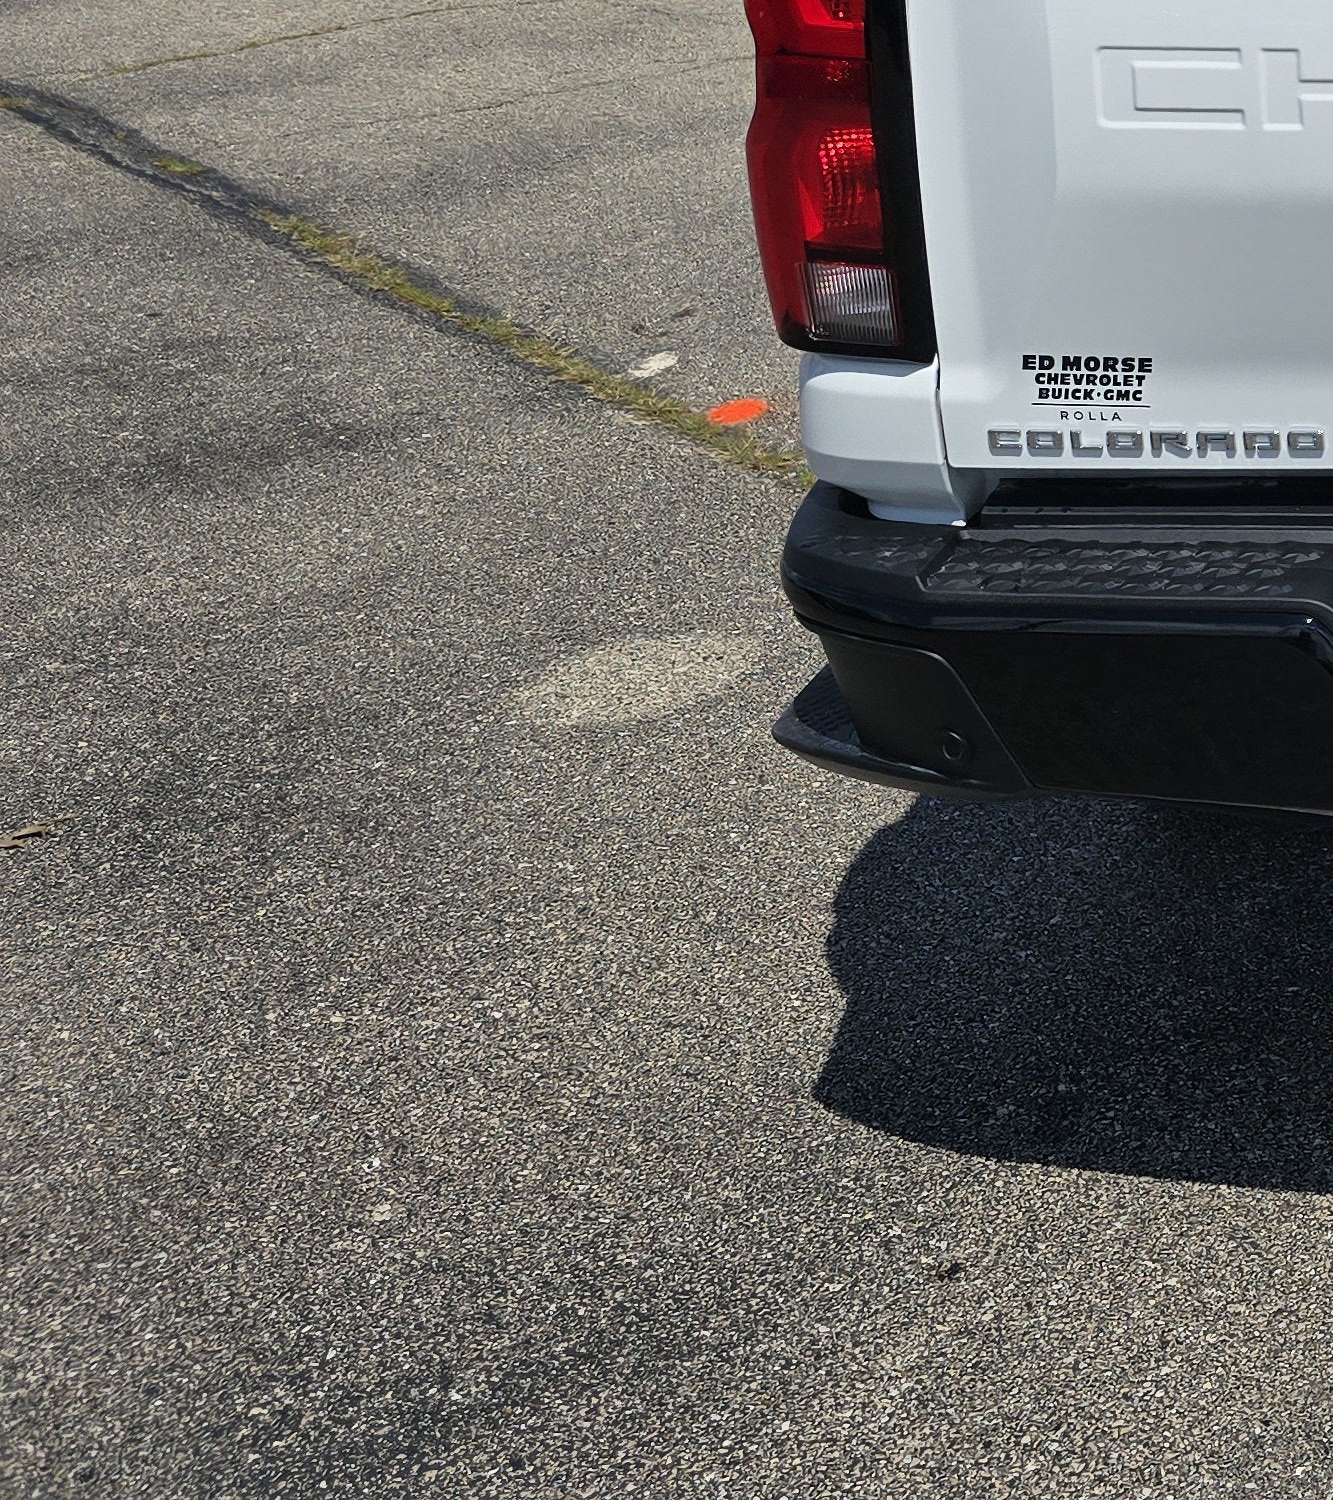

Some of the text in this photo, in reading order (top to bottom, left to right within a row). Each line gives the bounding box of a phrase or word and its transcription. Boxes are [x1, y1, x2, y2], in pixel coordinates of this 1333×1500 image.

[1022, 354, 1153, 374] ED MORSE
[1034, 372, 1146, 388] CHEVROLET
[1060, 410, 1122, 422] ROLLA
[987, 428, 1326, 456] COLORADO
